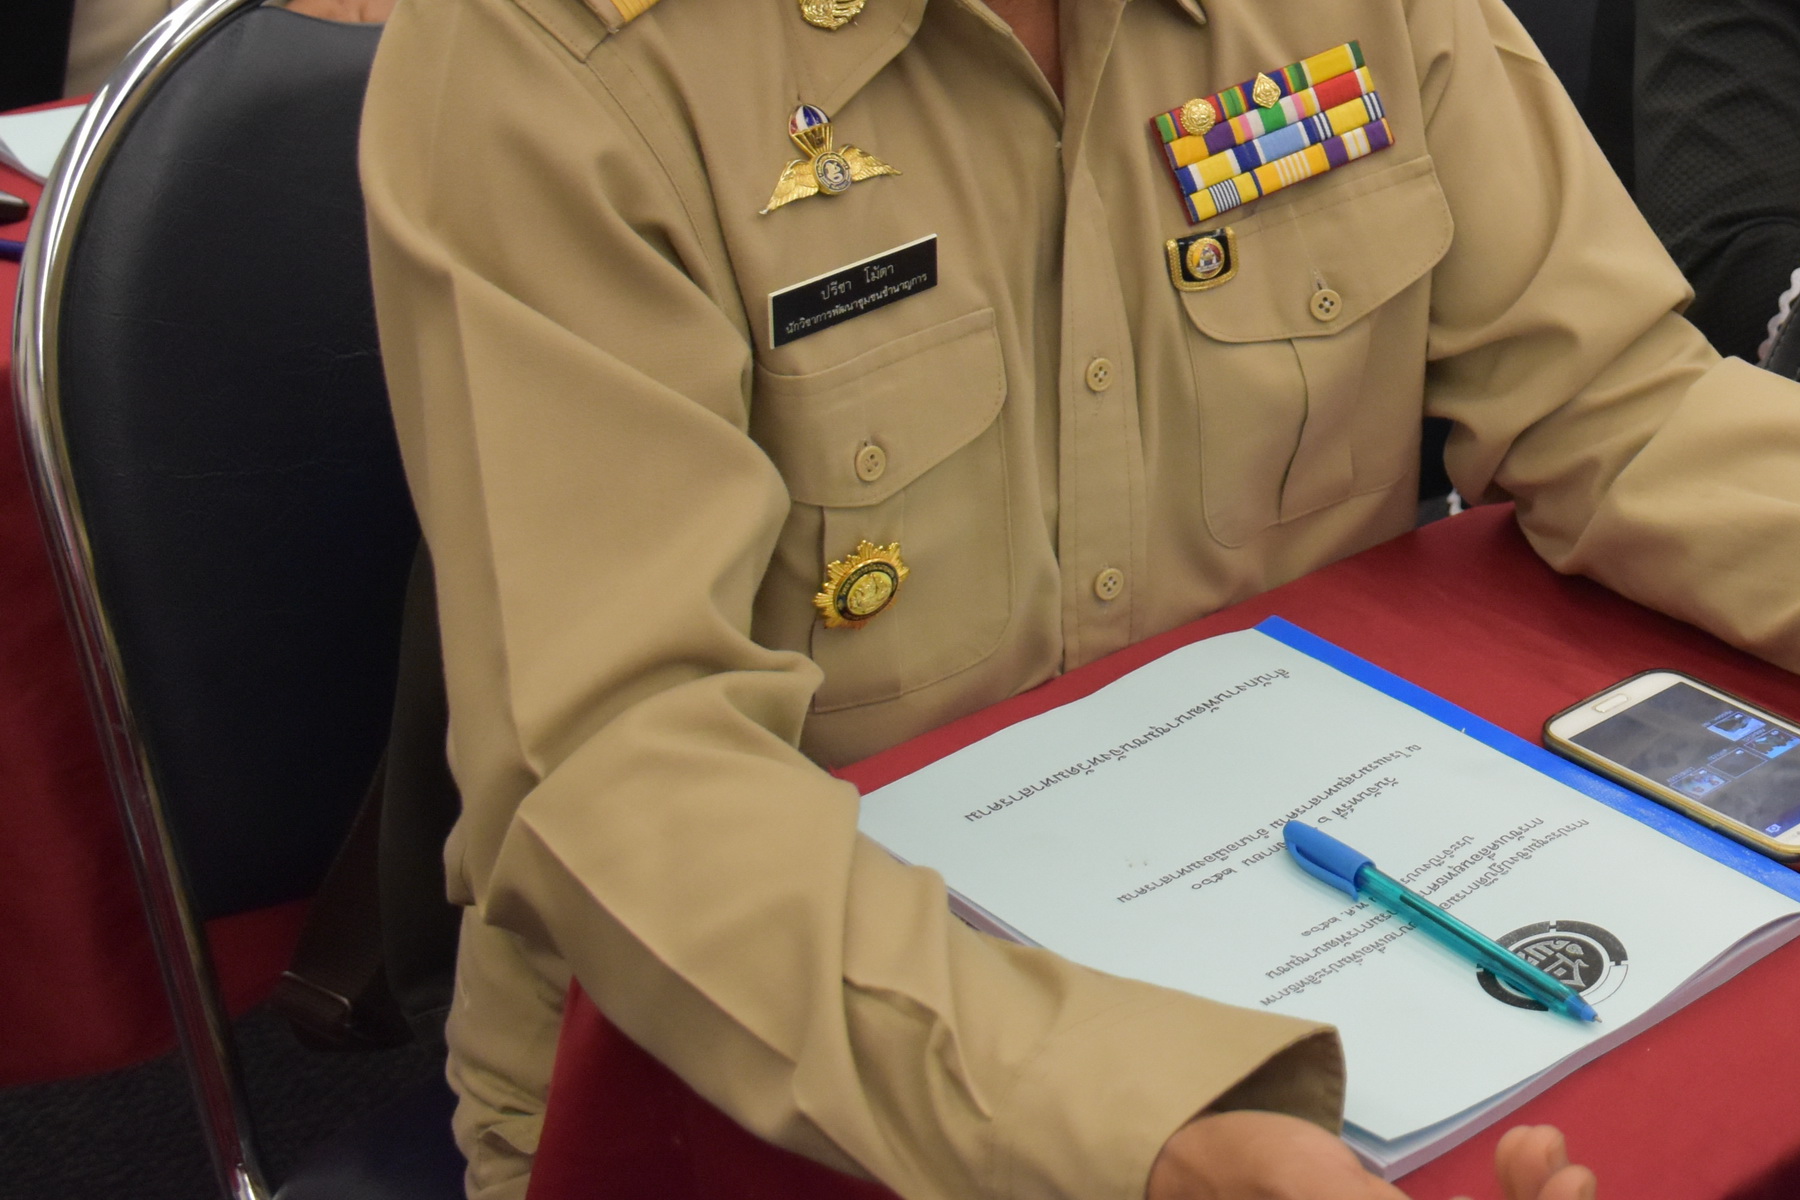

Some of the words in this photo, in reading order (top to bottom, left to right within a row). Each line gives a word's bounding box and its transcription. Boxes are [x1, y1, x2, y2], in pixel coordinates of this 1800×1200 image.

[820, 280, 852, 300] ปรีชา
[964, 667, 1290, 822] สำนักงานพัฒนาชุมชนจังหวัดมหาสารคาม
[1332, 775, 1399, 819] วันจันทร์ที่
[1117, 827, 1270, 903] อำเภอเมืองมหาสารคาม
[1191, 866, 1238, 890] ๒๕๖๐
[1340, 900, 1370, 917] พ.ศ.
[1300, 915, 1341, 937] ๒๕๖๑
